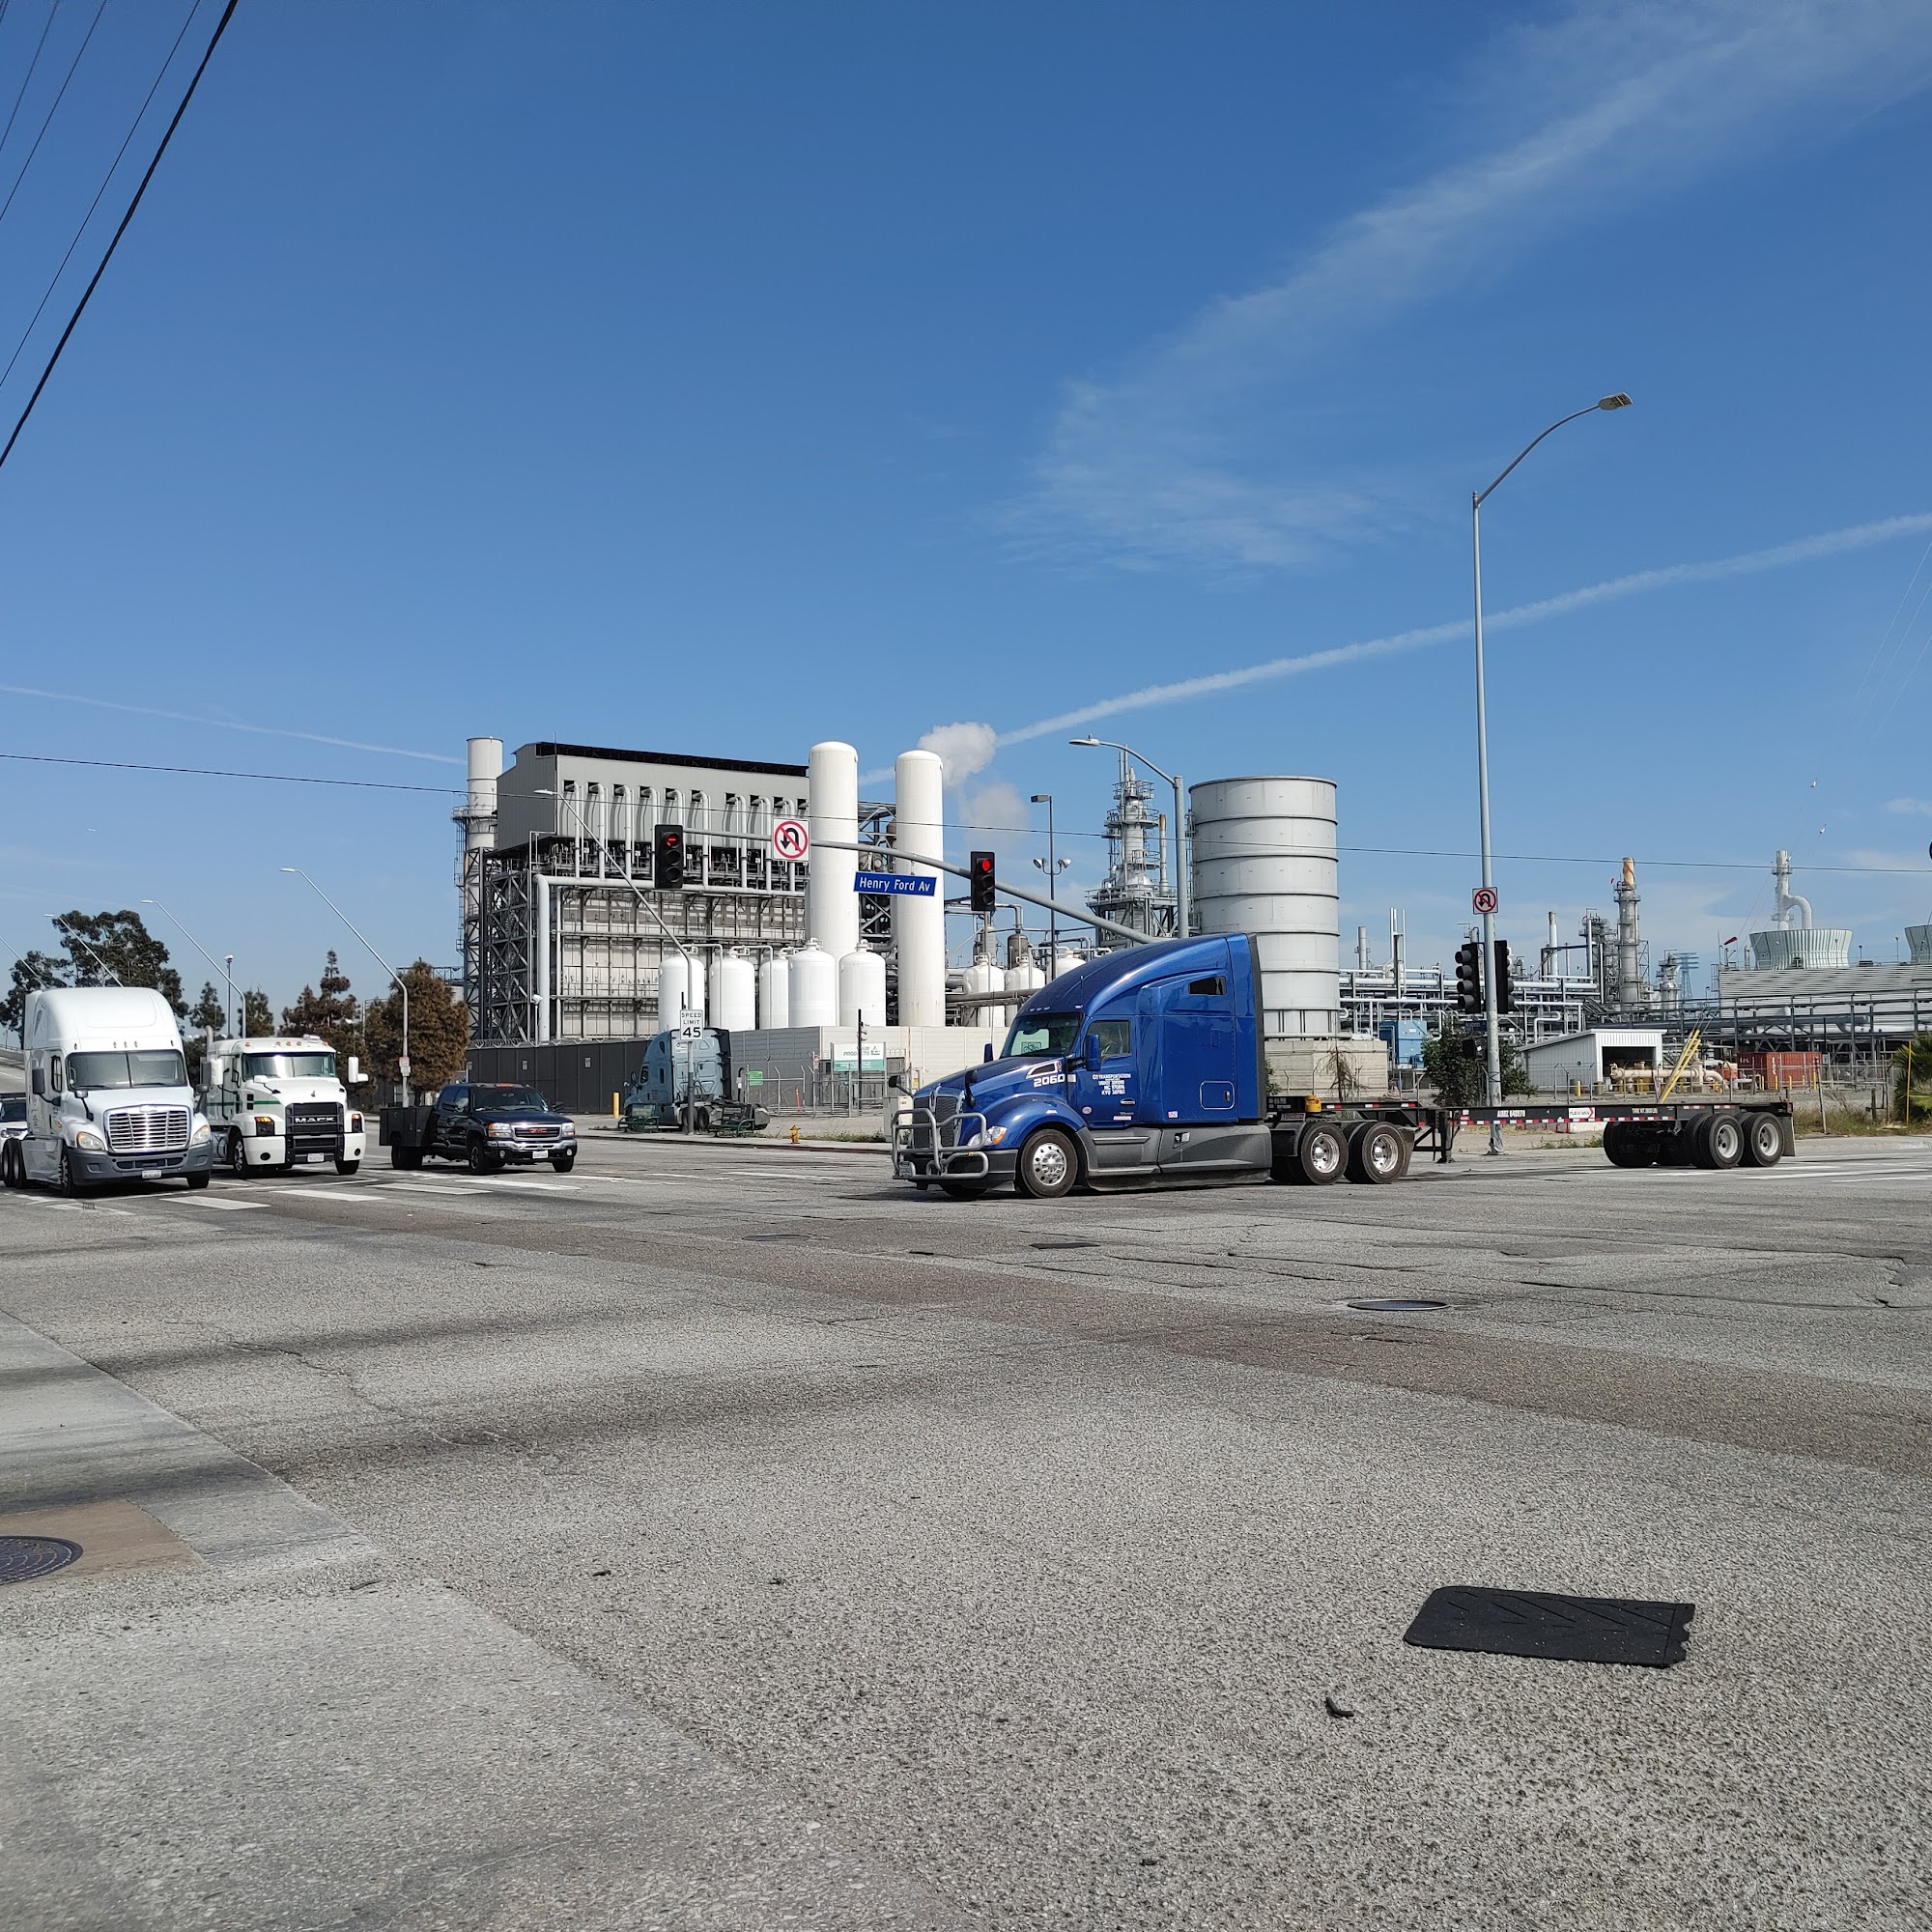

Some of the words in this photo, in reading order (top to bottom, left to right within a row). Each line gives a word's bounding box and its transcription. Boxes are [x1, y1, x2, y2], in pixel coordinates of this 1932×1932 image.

[859, 876, 890, 892] Henry
[894, 879, 915, 892] Ford
[918, 880, 930, 893] Av
[682, 1026, 701, 1038] 45
[1034, 1073, 1065, 1088] 2060
